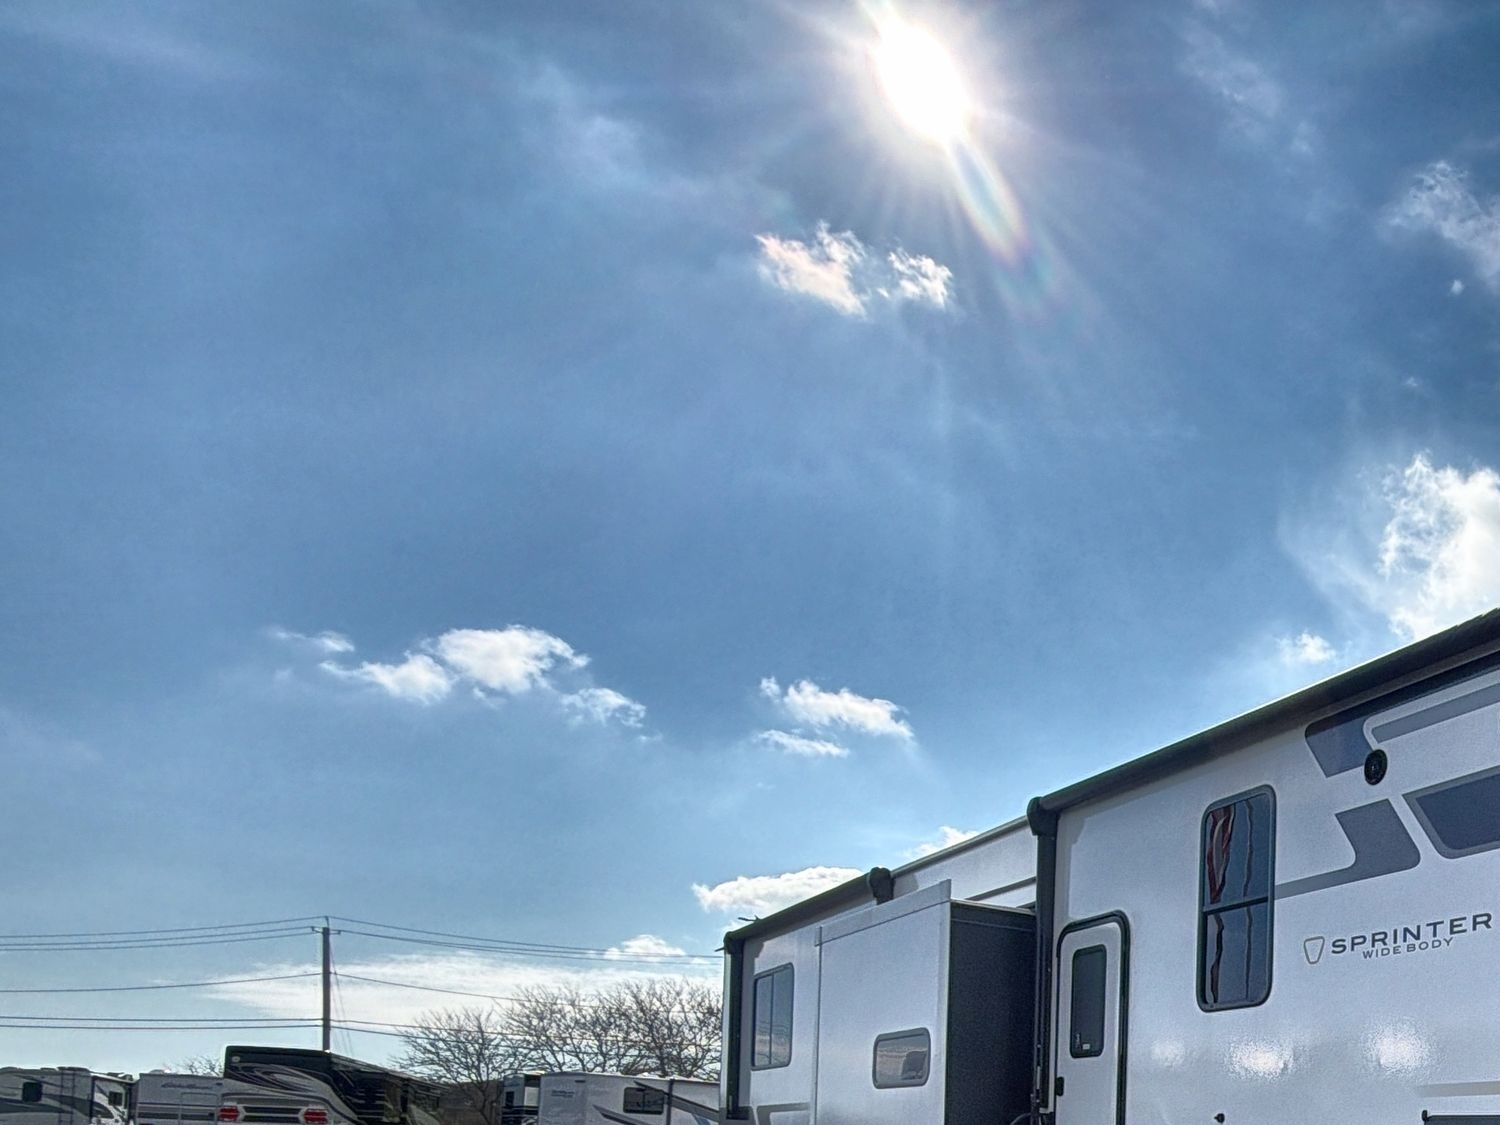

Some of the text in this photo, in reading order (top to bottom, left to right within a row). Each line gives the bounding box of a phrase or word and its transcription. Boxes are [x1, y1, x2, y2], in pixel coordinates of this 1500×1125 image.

[1331, 912, 1493, 954] SPRINTER
[1362, 937, 1454, 960] WIDE BODY
